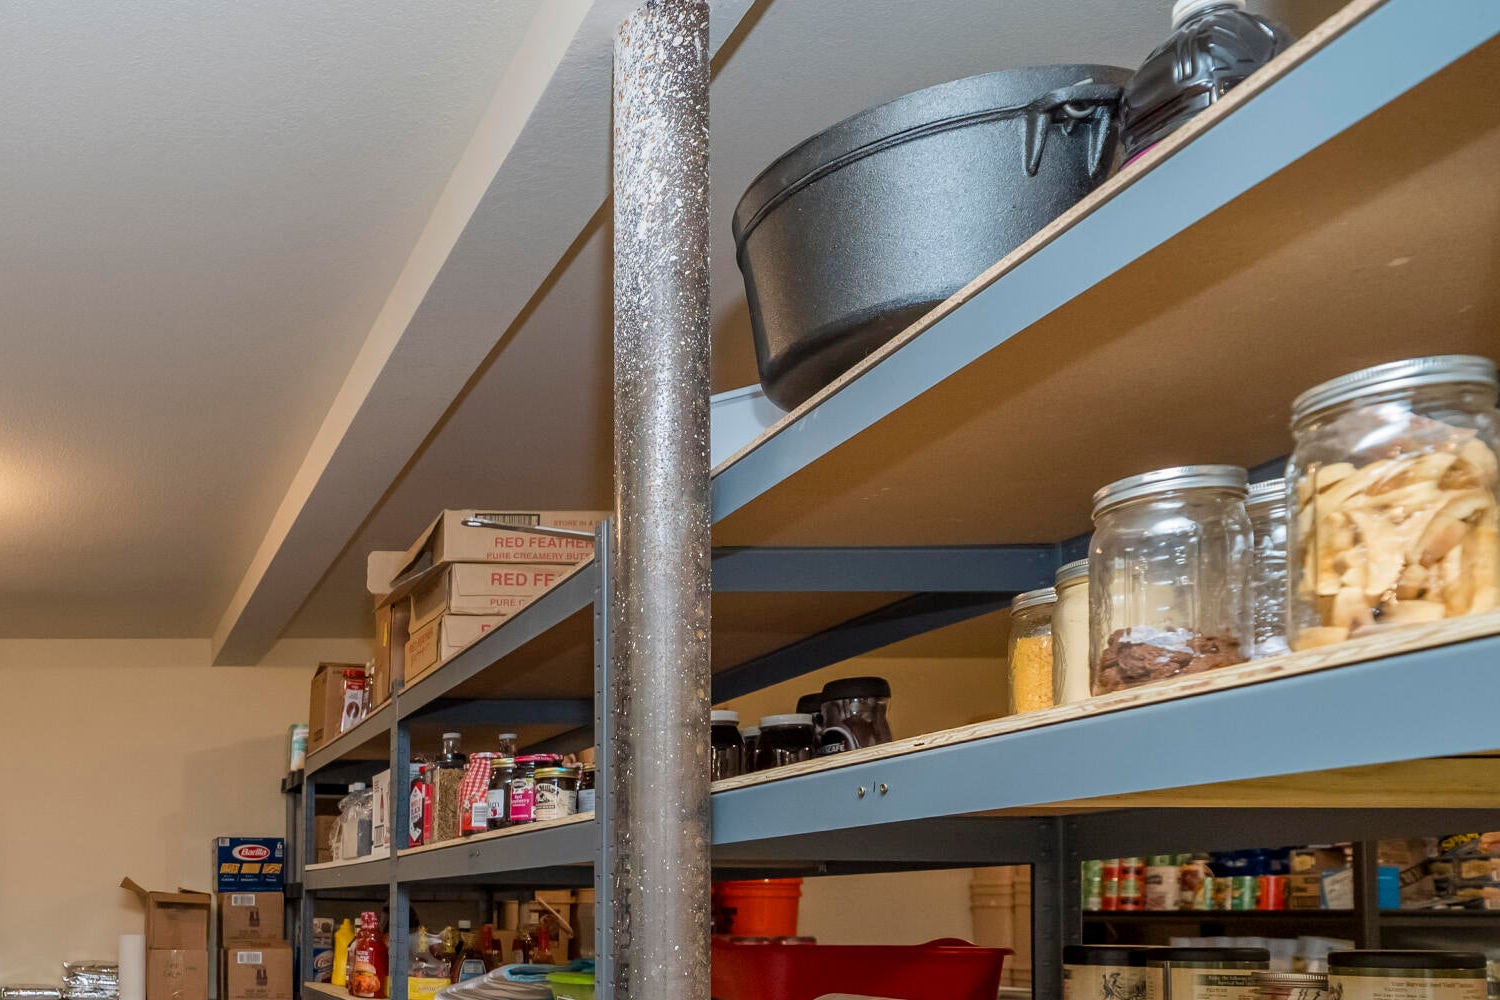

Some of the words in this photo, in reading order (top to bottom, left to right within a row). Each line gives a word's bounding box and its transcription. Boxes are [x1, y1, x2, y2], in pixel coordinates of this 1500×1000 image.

[495, 537, 524, 548] RED
[529, 537, 595, 548] FEATHER
[486, 552, 511, 560] PURE
[513, 552, 563, 560] CREAMERY
[490, 573, 527, 586] RED
[240, 847, 267, 857] Barilla
